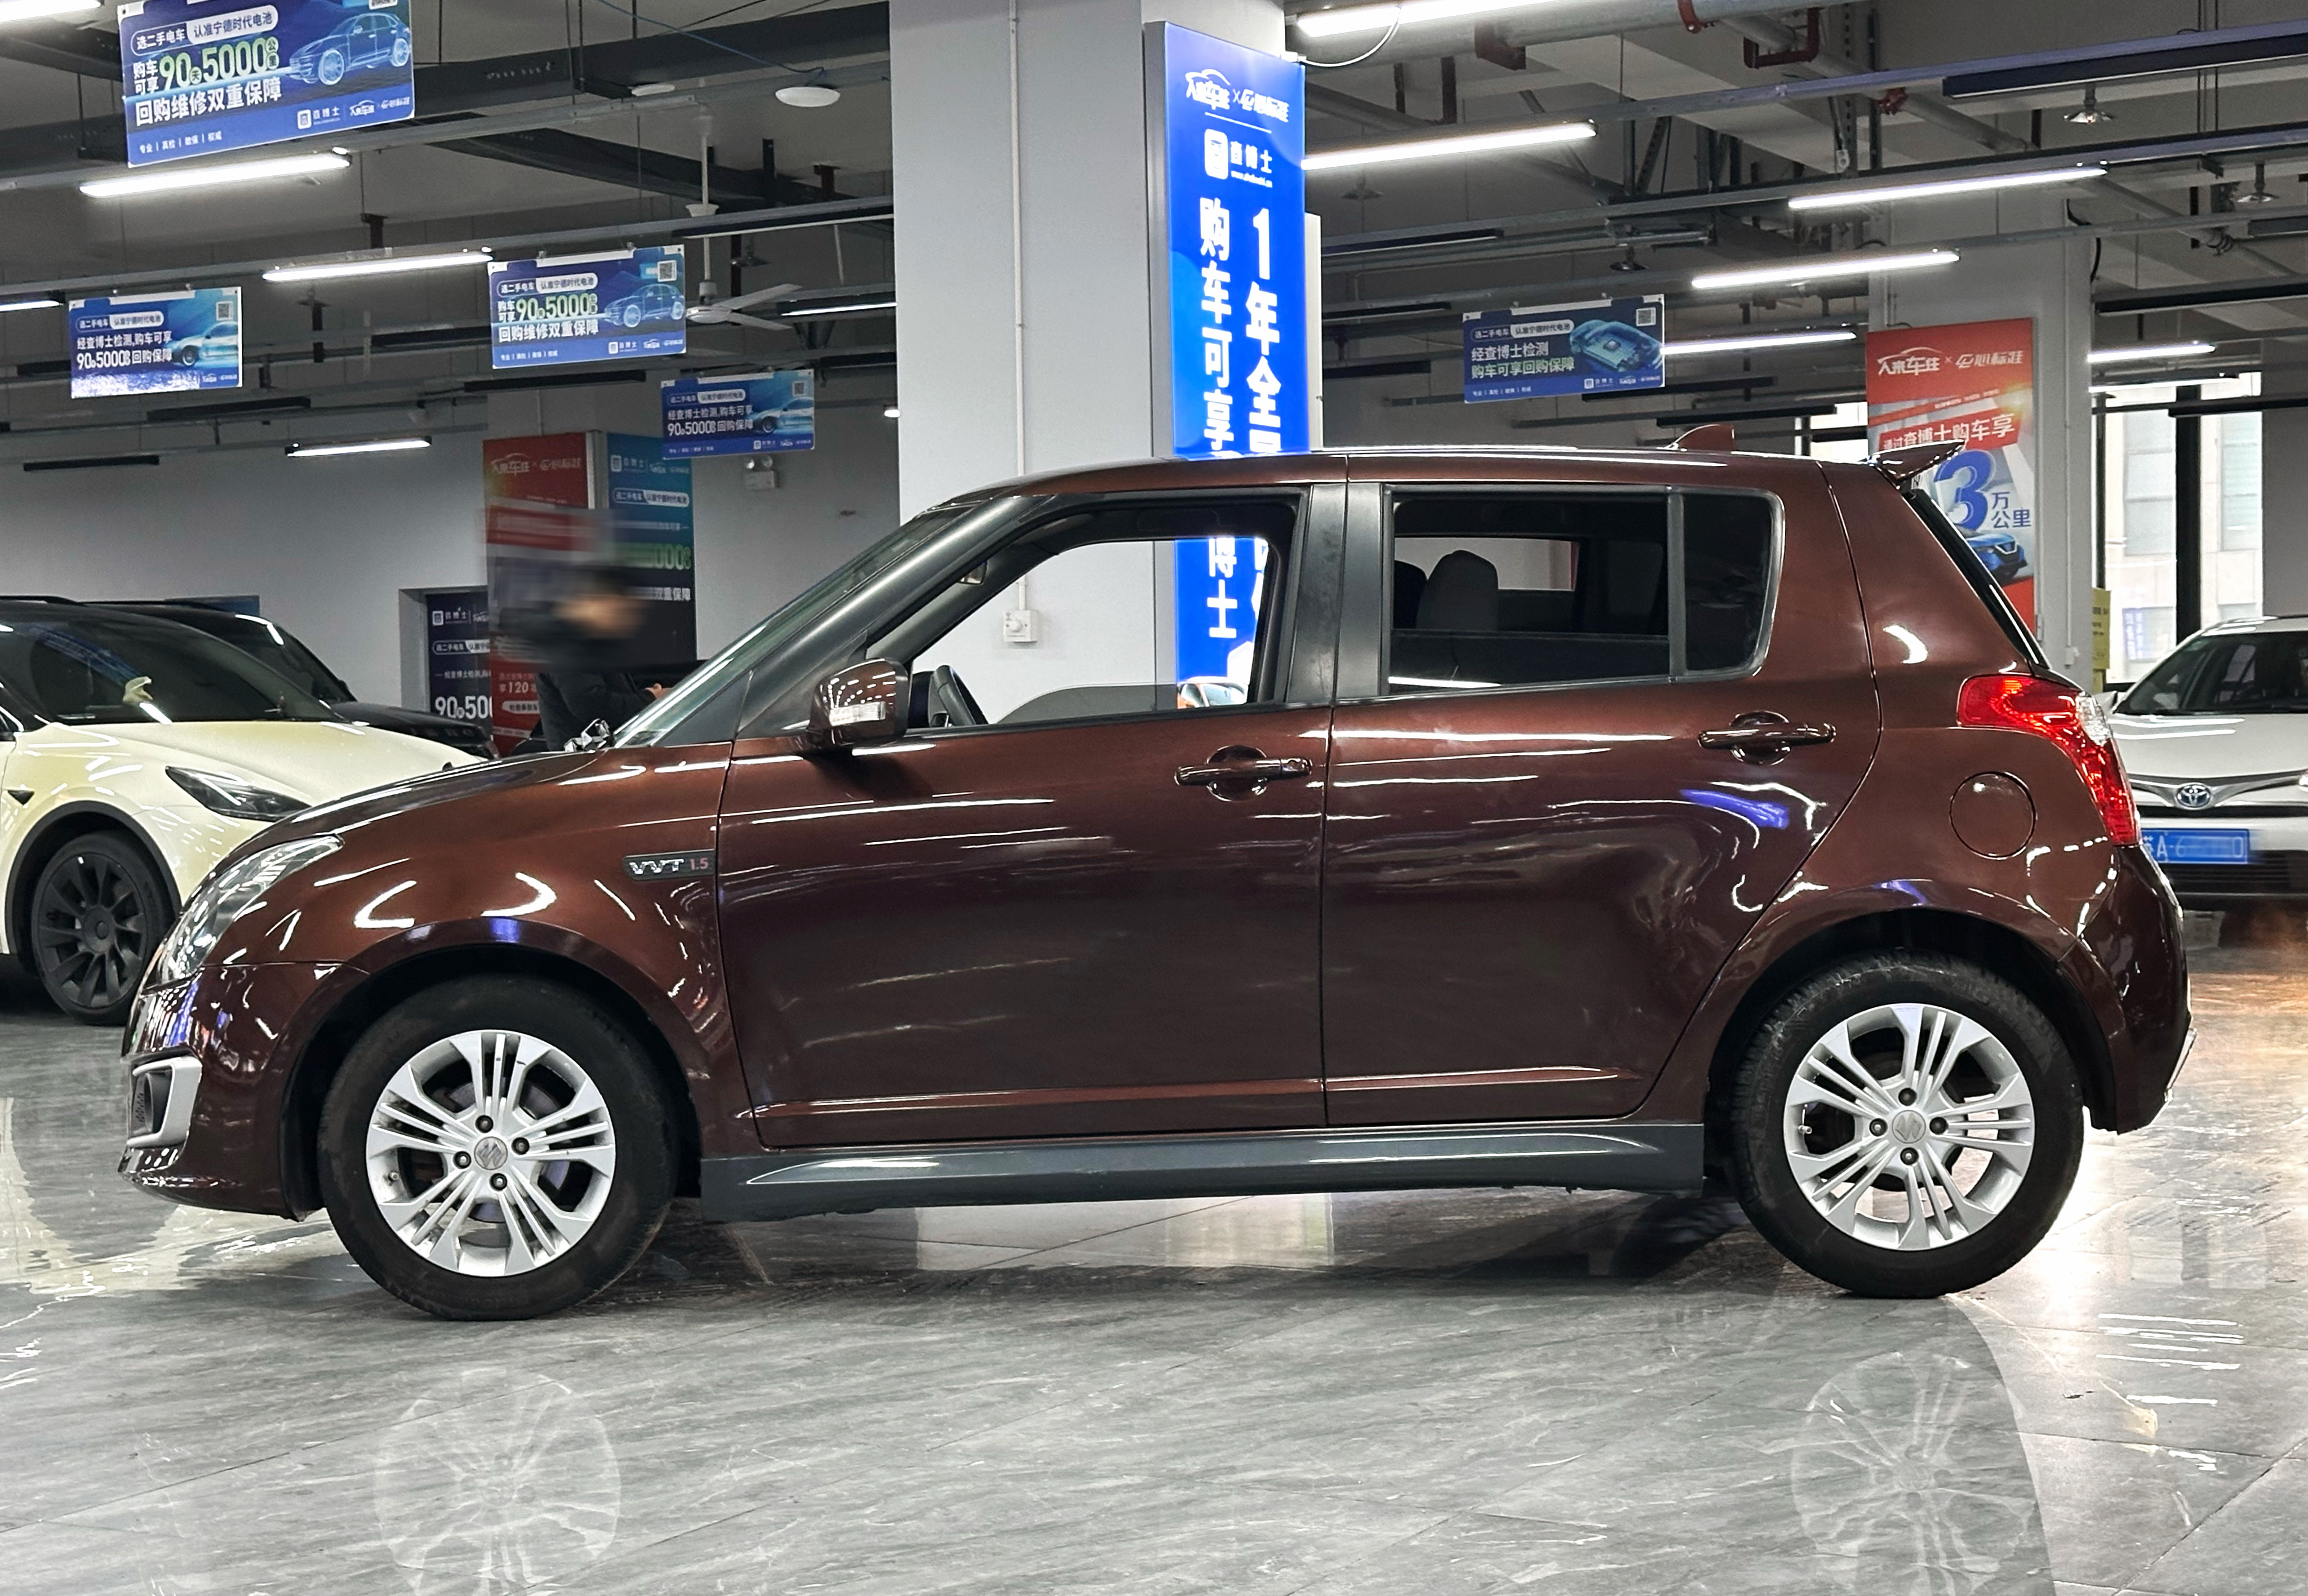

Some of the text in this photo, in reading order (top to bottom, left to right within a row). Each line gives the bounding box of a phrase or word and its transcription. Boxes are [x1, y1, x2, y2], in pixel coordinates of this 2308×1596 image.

[136, 12, 273, 50] 选二手电车 认准宁德时代电池
[133, 59, 158, 79] 购车
[134, 77, 159, 96] 可享
[135, 76, 282, 127] 回购维修双重保障
[498, 318, 599, 343] 回购维修双重保障
[1199, 197, 1235, 451] 购车可享
[1471, 341, 1550, 362] 经查博士检测
[1471, 355, 1575, 379] 购车可享回购保障
[1934, 450, 2031, 531] 3 万 公里
[629, 857, 709, 874] VVT 1.5
